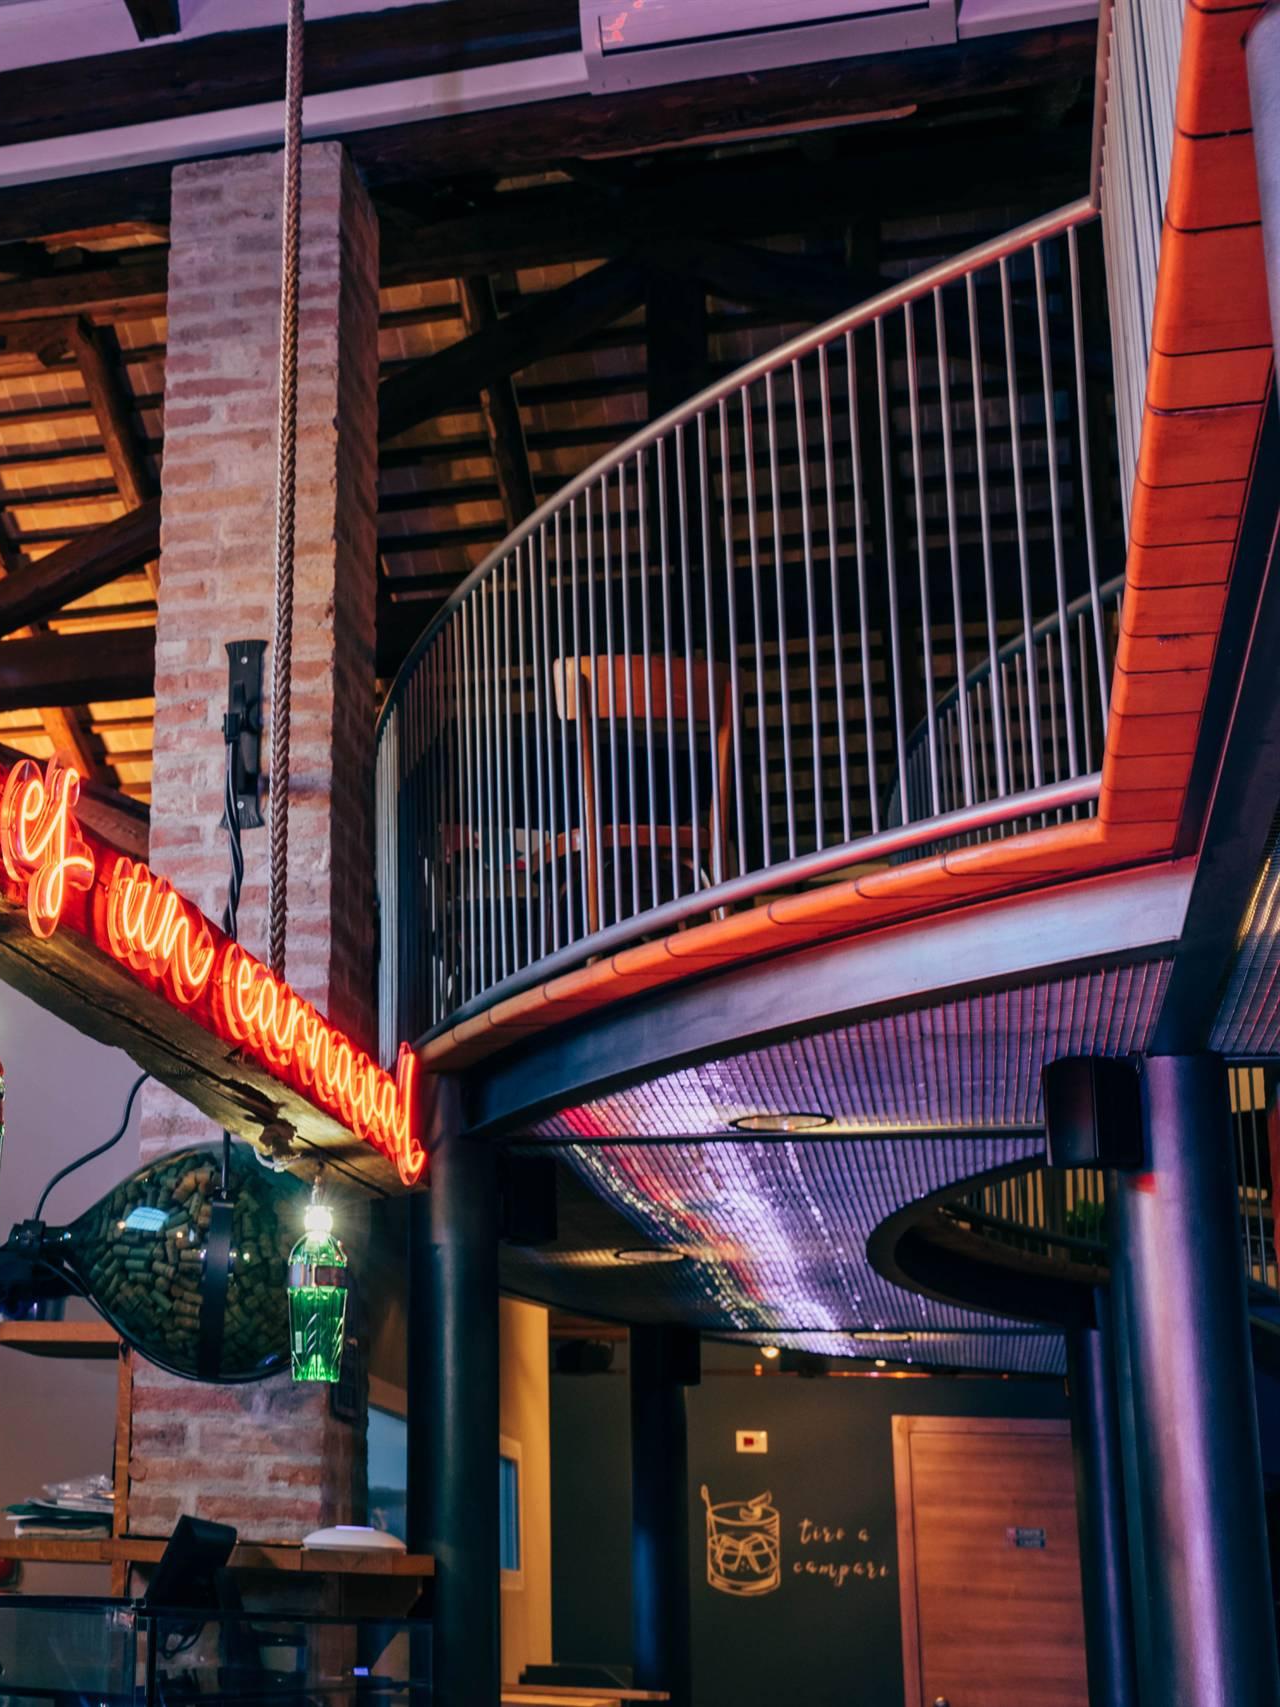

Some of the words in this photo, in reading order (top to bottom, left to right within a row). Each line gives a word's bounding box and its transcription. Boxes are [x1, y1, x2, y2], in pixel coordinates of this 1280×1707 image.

[108, 860, 214, 1001] un
[226, 945, 426, 1184] carnaval
[858, 1528, 870, 1542] a
[793, 1561, 887, 1587] campari
